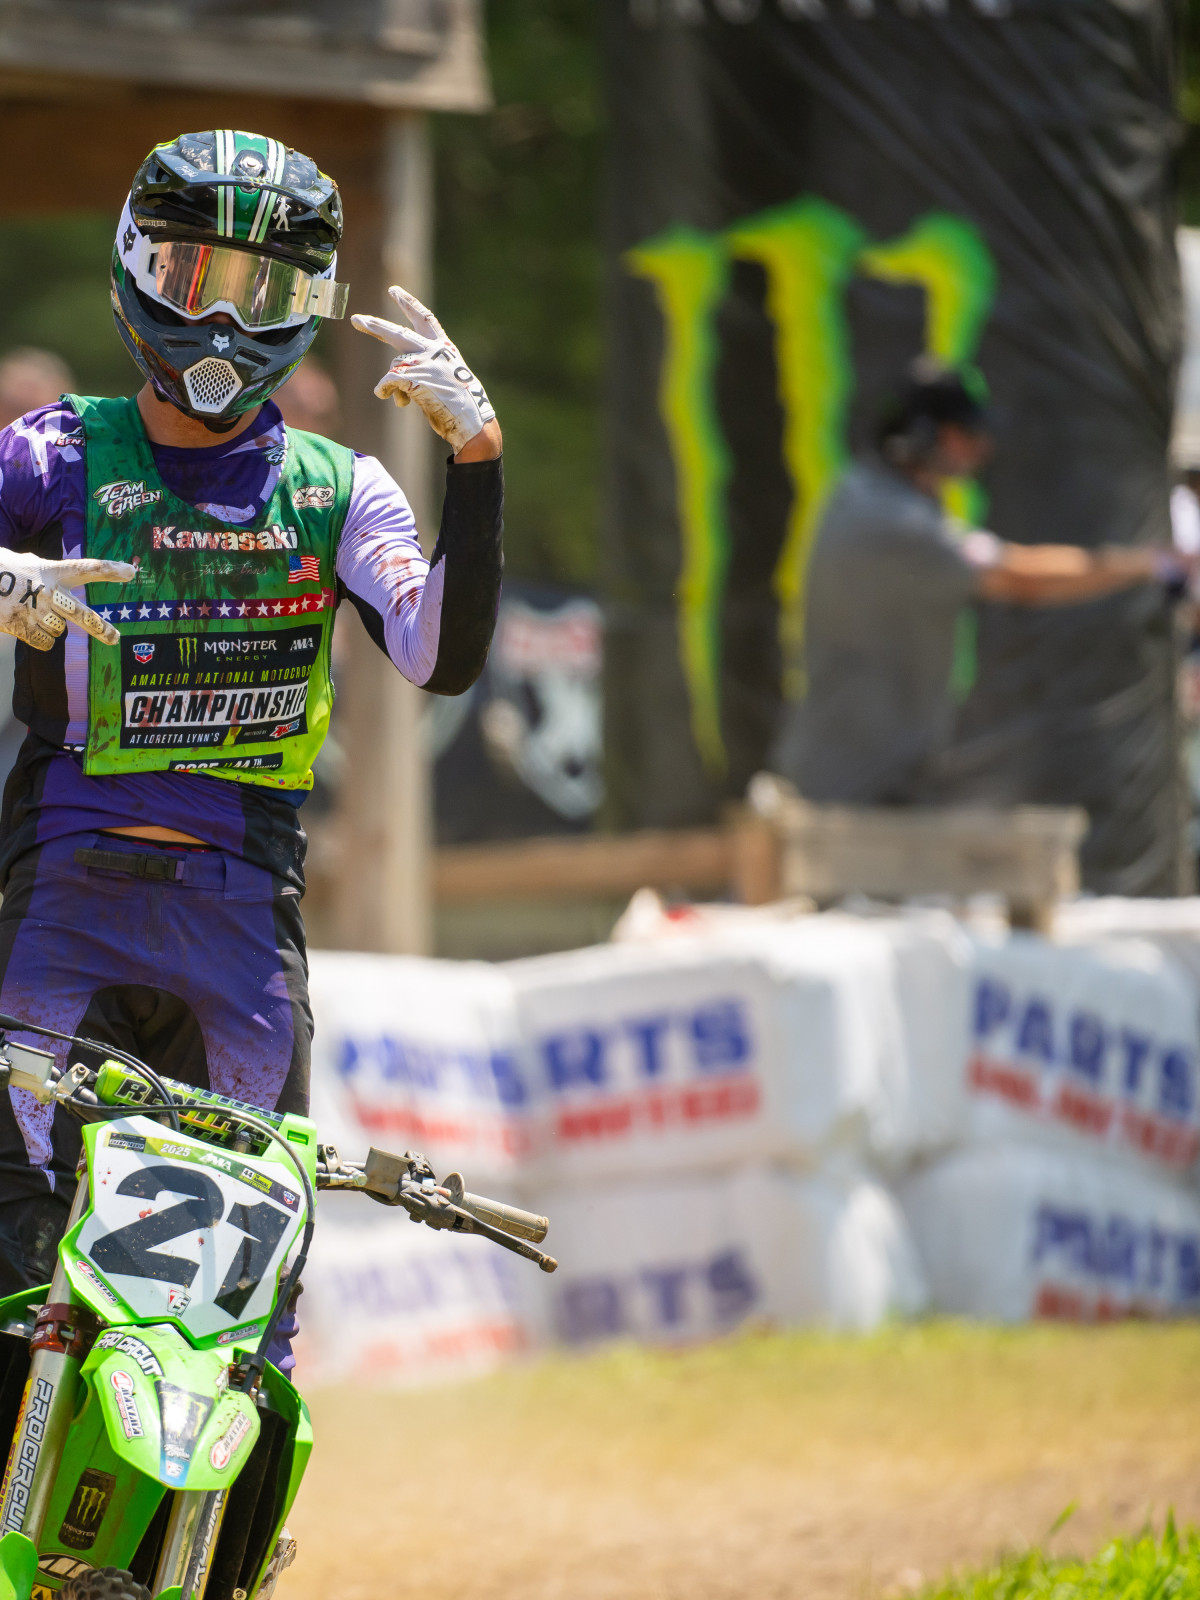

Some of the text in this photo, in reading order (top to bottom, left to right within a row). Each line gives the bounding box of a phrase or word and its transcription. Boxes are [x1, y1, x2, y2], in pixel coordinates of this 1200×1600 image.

[431, 347, 489, 408] FOX
[96, 481, 145, 504] TEAM
[108, 491, 161, 517] GREEN
[319, 490, 330, 498] 39
[153, 525, 298, 551] Kawasaki
[203, 638, 277, 653] MONSTER
[216, 654, 268, 662] ENERGY
[131, 665, 313, 686] AMATEUR NATIONAL MOTOCROS
[129, 685, 308, 724] CHAMPIONSHIP
[130, 732, 220, 744] AT LORETTA LYNN'S
[160, 1143, 191, 1157] 2025
[243, 1169, 253, 1178] 44
[89, 1165, 291, 1320] 21
[93, 1331, 164, 1377] PRO CIRCUIT
[26, 1378, 54, 1442] PRO
